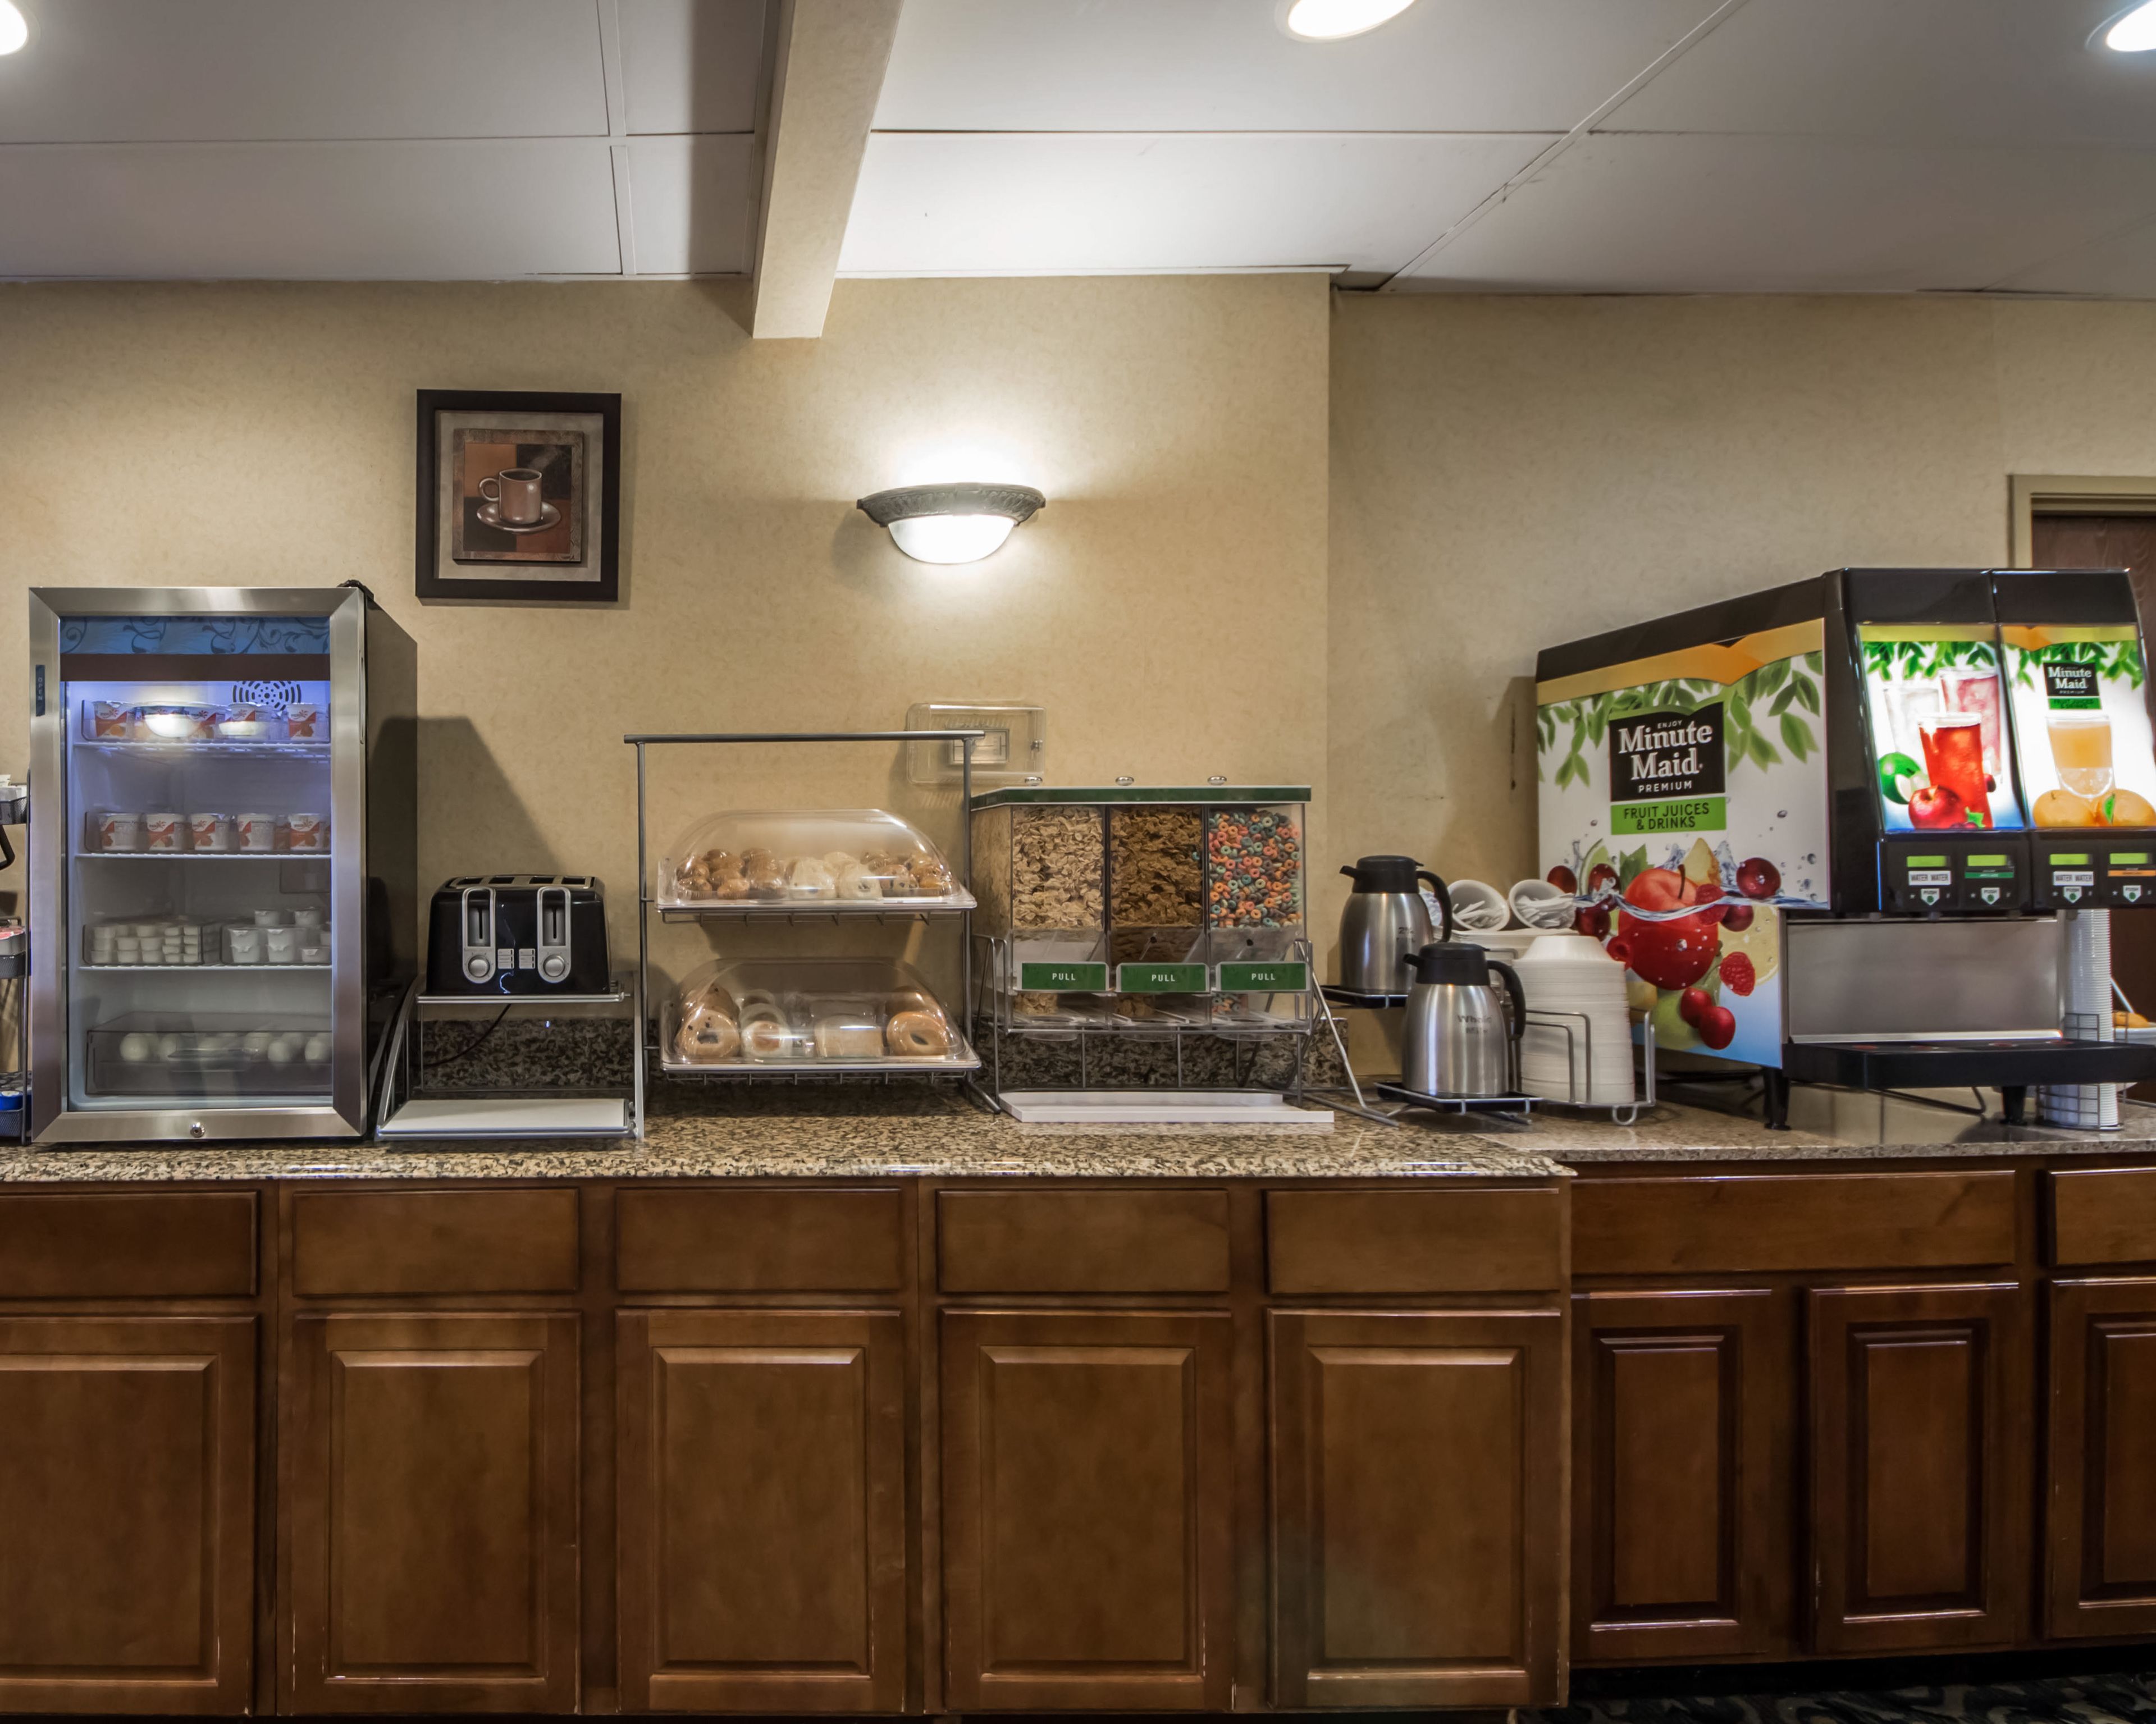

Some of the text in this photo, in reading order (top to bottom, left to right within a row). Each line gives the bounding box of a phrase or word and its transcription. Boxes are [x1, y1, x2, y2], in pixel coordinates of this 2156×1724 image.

[2048, 666, 2093, 678] Minute
[2055, 678, 2088, 689] Maid
[1657, 720, 1683, 729] ENJOY
[1618, 720, 1713, 754] Minute
[1630, 747, 1700, 780] Maid
[1638, 780, 1692, 793] PREMIUM
[1624, 802, 1710, 820] FRUIT JUICES
[1636, 816, 1696, 830] & DRINKS
